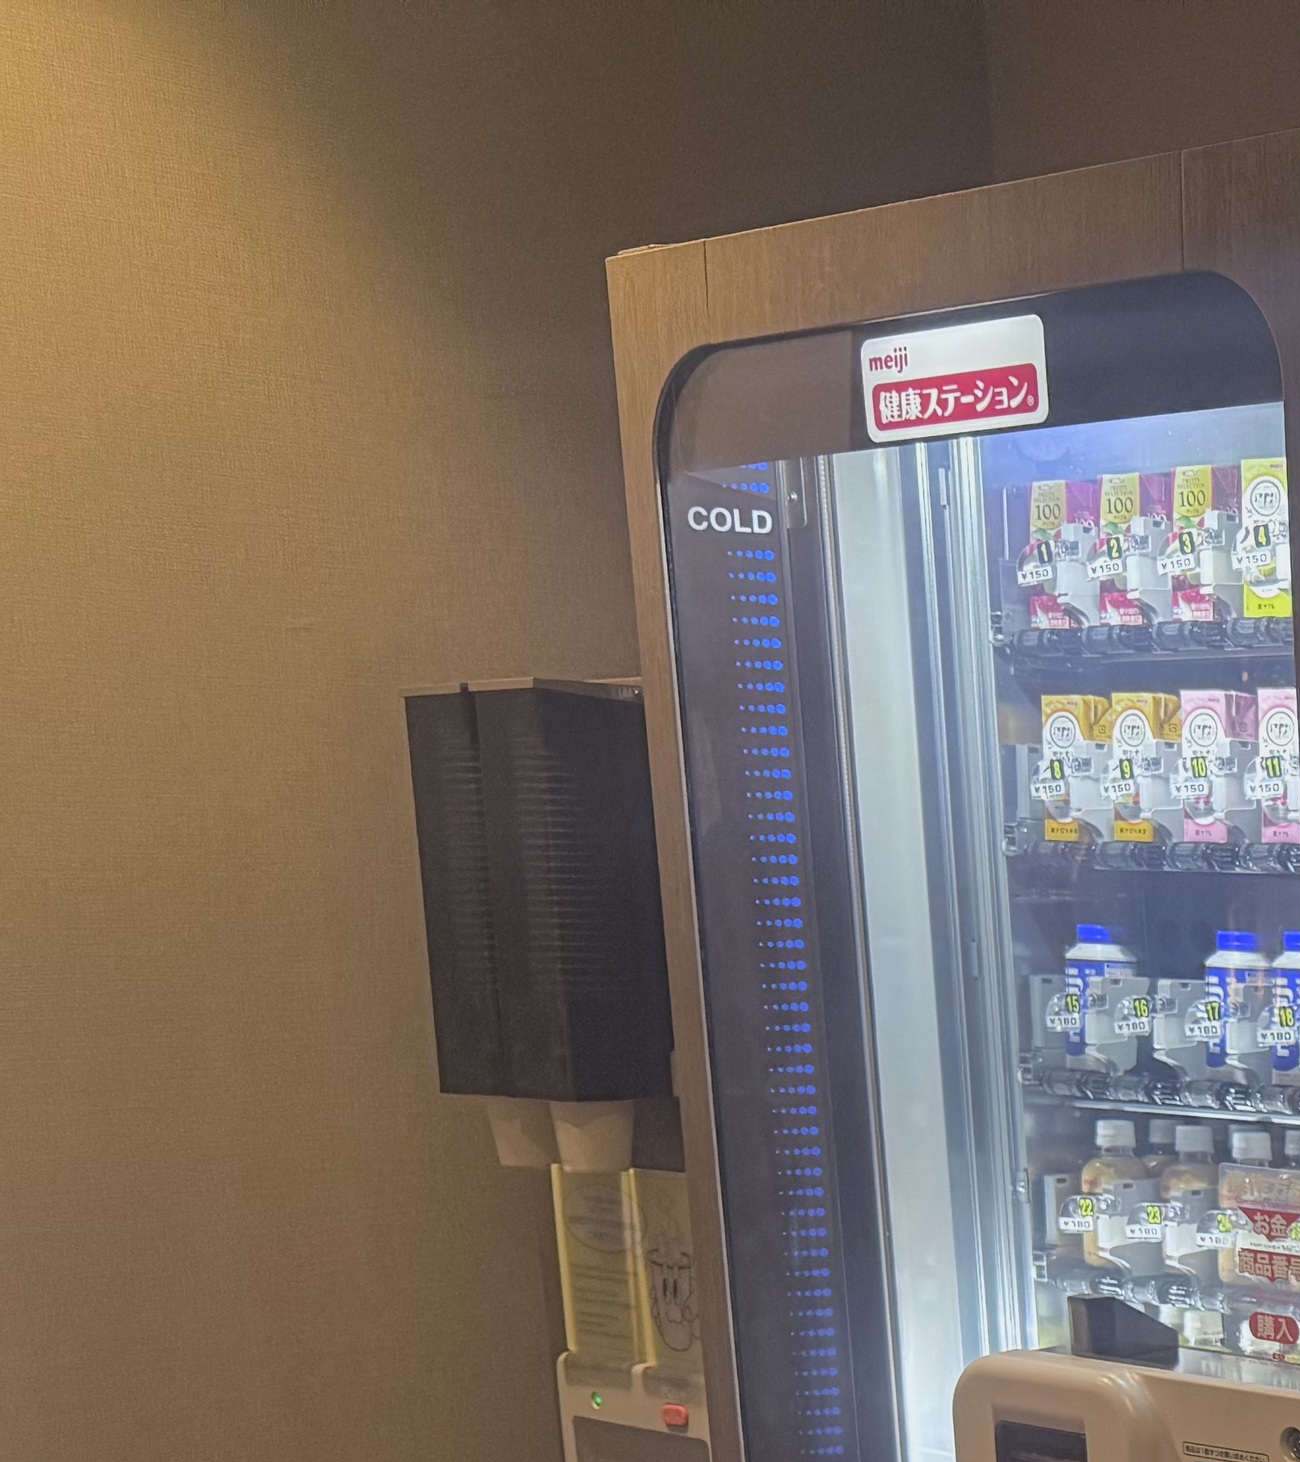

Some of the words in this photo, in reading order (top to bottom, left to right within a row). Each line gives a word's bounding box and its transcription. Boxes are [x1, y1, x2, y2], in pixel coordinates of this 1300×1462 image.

[868, 345, 909, 373] meiji
[878, 374, 1030, 424] 健康ステーション
[1106, 497, 1134, 515] 100
[1179, 490, 1206, 507] 100
[688, 506, 773, 535] COLD
[1035, 504, 1061, 521] 100
[1258, 527, 1267, 545] 4
[1161, 558, 1191, 570] ¥150
[1236, 553, 1268, 565] ¥150
[1254, 1213, 1287, 1236] お金
[1257, 1316, 1293, 1343] 購入
